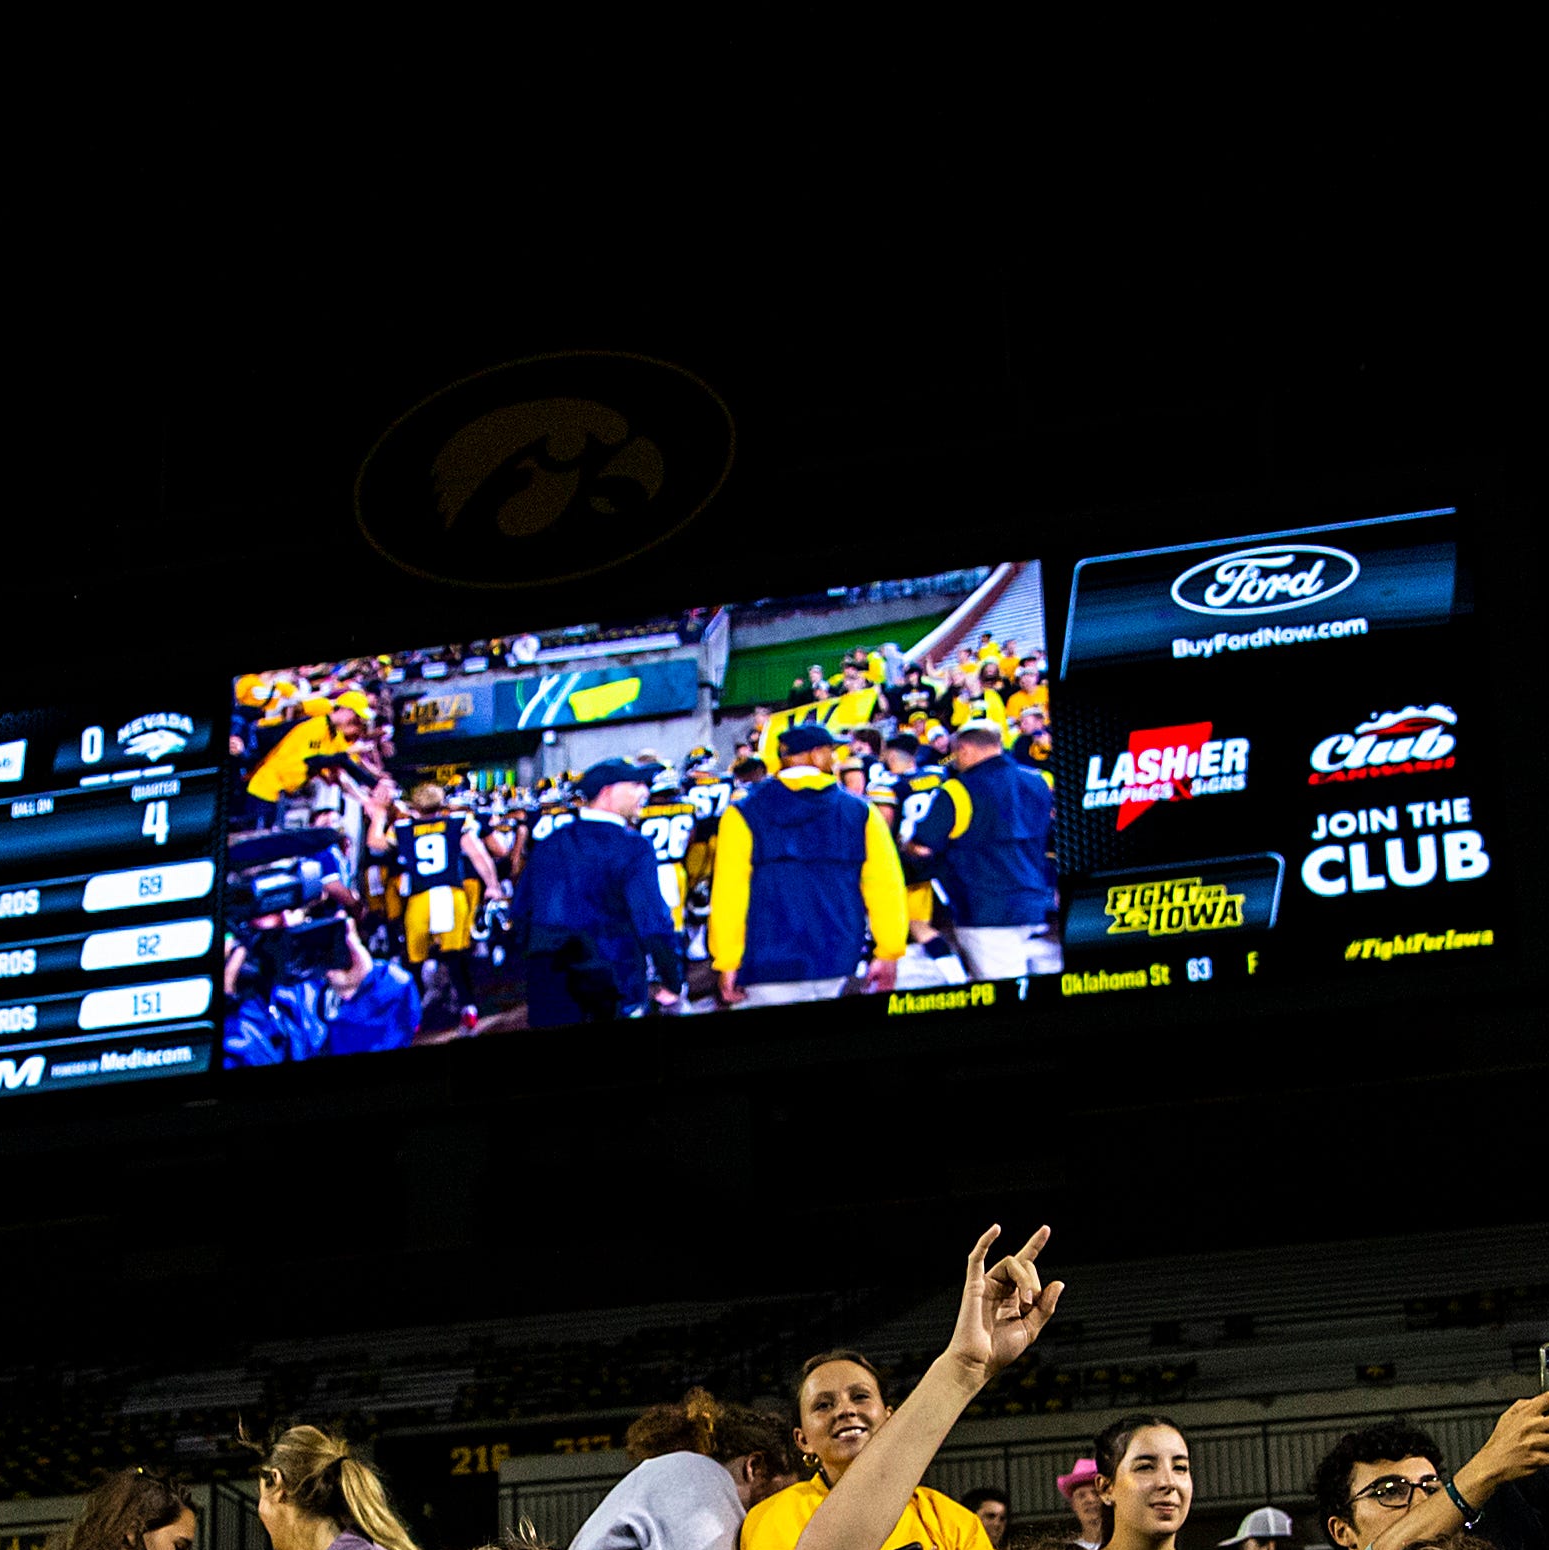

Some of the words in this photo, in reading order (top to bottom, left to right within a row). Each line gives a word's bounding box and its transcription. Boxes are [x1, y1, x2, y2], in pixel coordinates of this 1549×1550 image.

[1204, 553, 1325, 607] Ford
[1172, 618, 1368, 658] BuyFordNow.com
[81, 725, 105, 764] 0
[1085, 738, 1250, 790] LASHIER
[1309, 725, 1457, 773] Club
[142, 801, 170, 845] 4
[1311, 803, 1397, 841] JOIN
[1407, 796, 1472, 830] THE
[414, 834, 448, 875] 9
[1300, 830, 1490, 897] CLUB
[1109, 880, 1199, 911] FIGHT
[1151, 898, 1241, 932] IOWA
[137, 934, 162, 957] 82
[1015, 978, 1028, 1001] 7
[1061, 967, 1147, 998] Oklahoma
[1150, 964, 1171, 987] St
[132, 993, 163, 1015] 151
[100, 1046, 193, 1072] Mediacom
